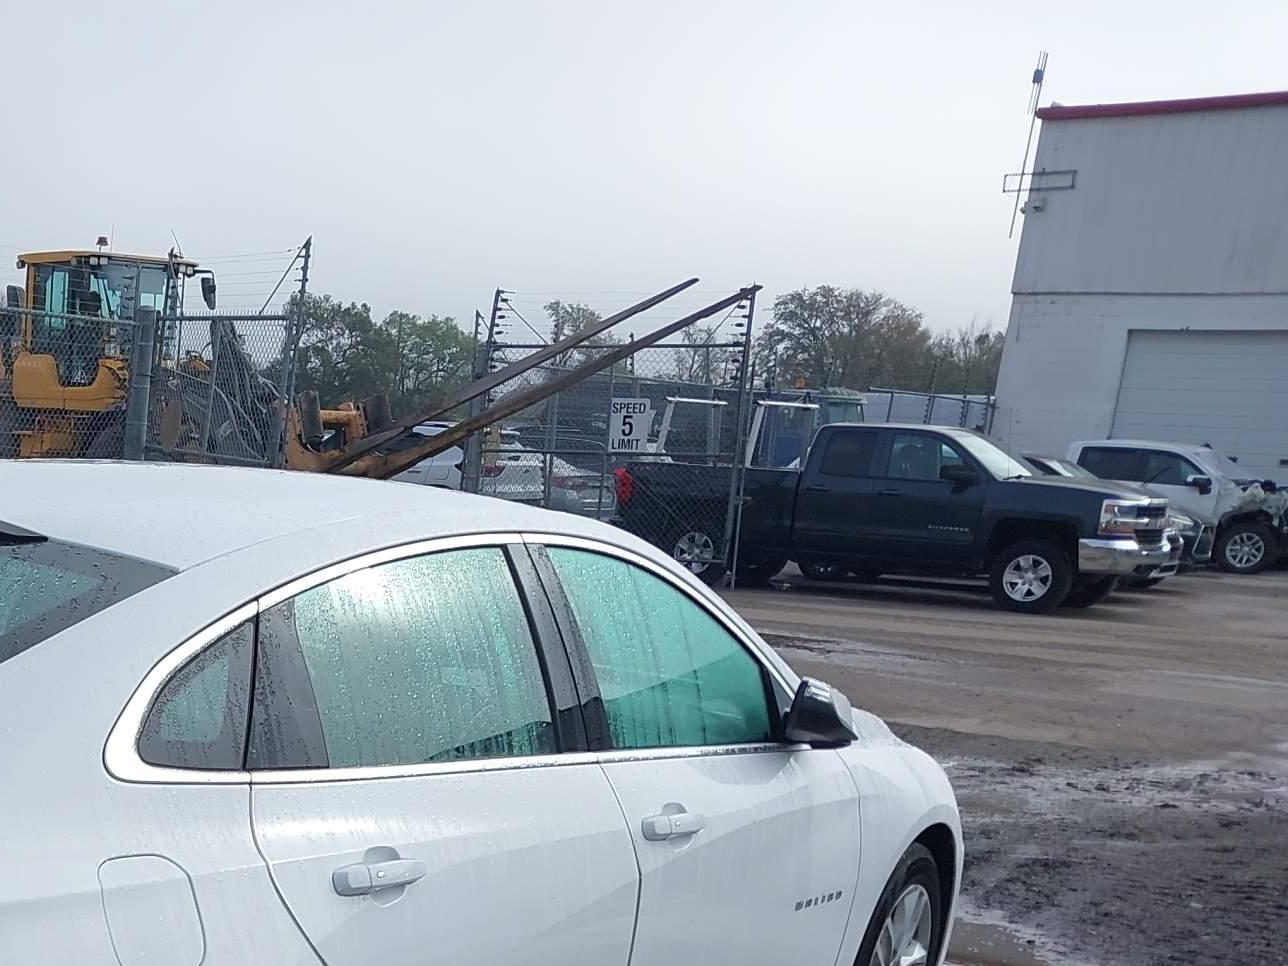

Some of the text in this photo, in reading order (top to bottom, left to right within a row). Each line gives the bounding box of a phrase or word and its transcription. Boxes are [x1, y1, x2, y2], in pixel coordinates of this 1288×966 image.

[612, 402, 647, 414] SPEED
[621, 414, 634, 437] 5
[611, 438, 641, 451] LIMIT
